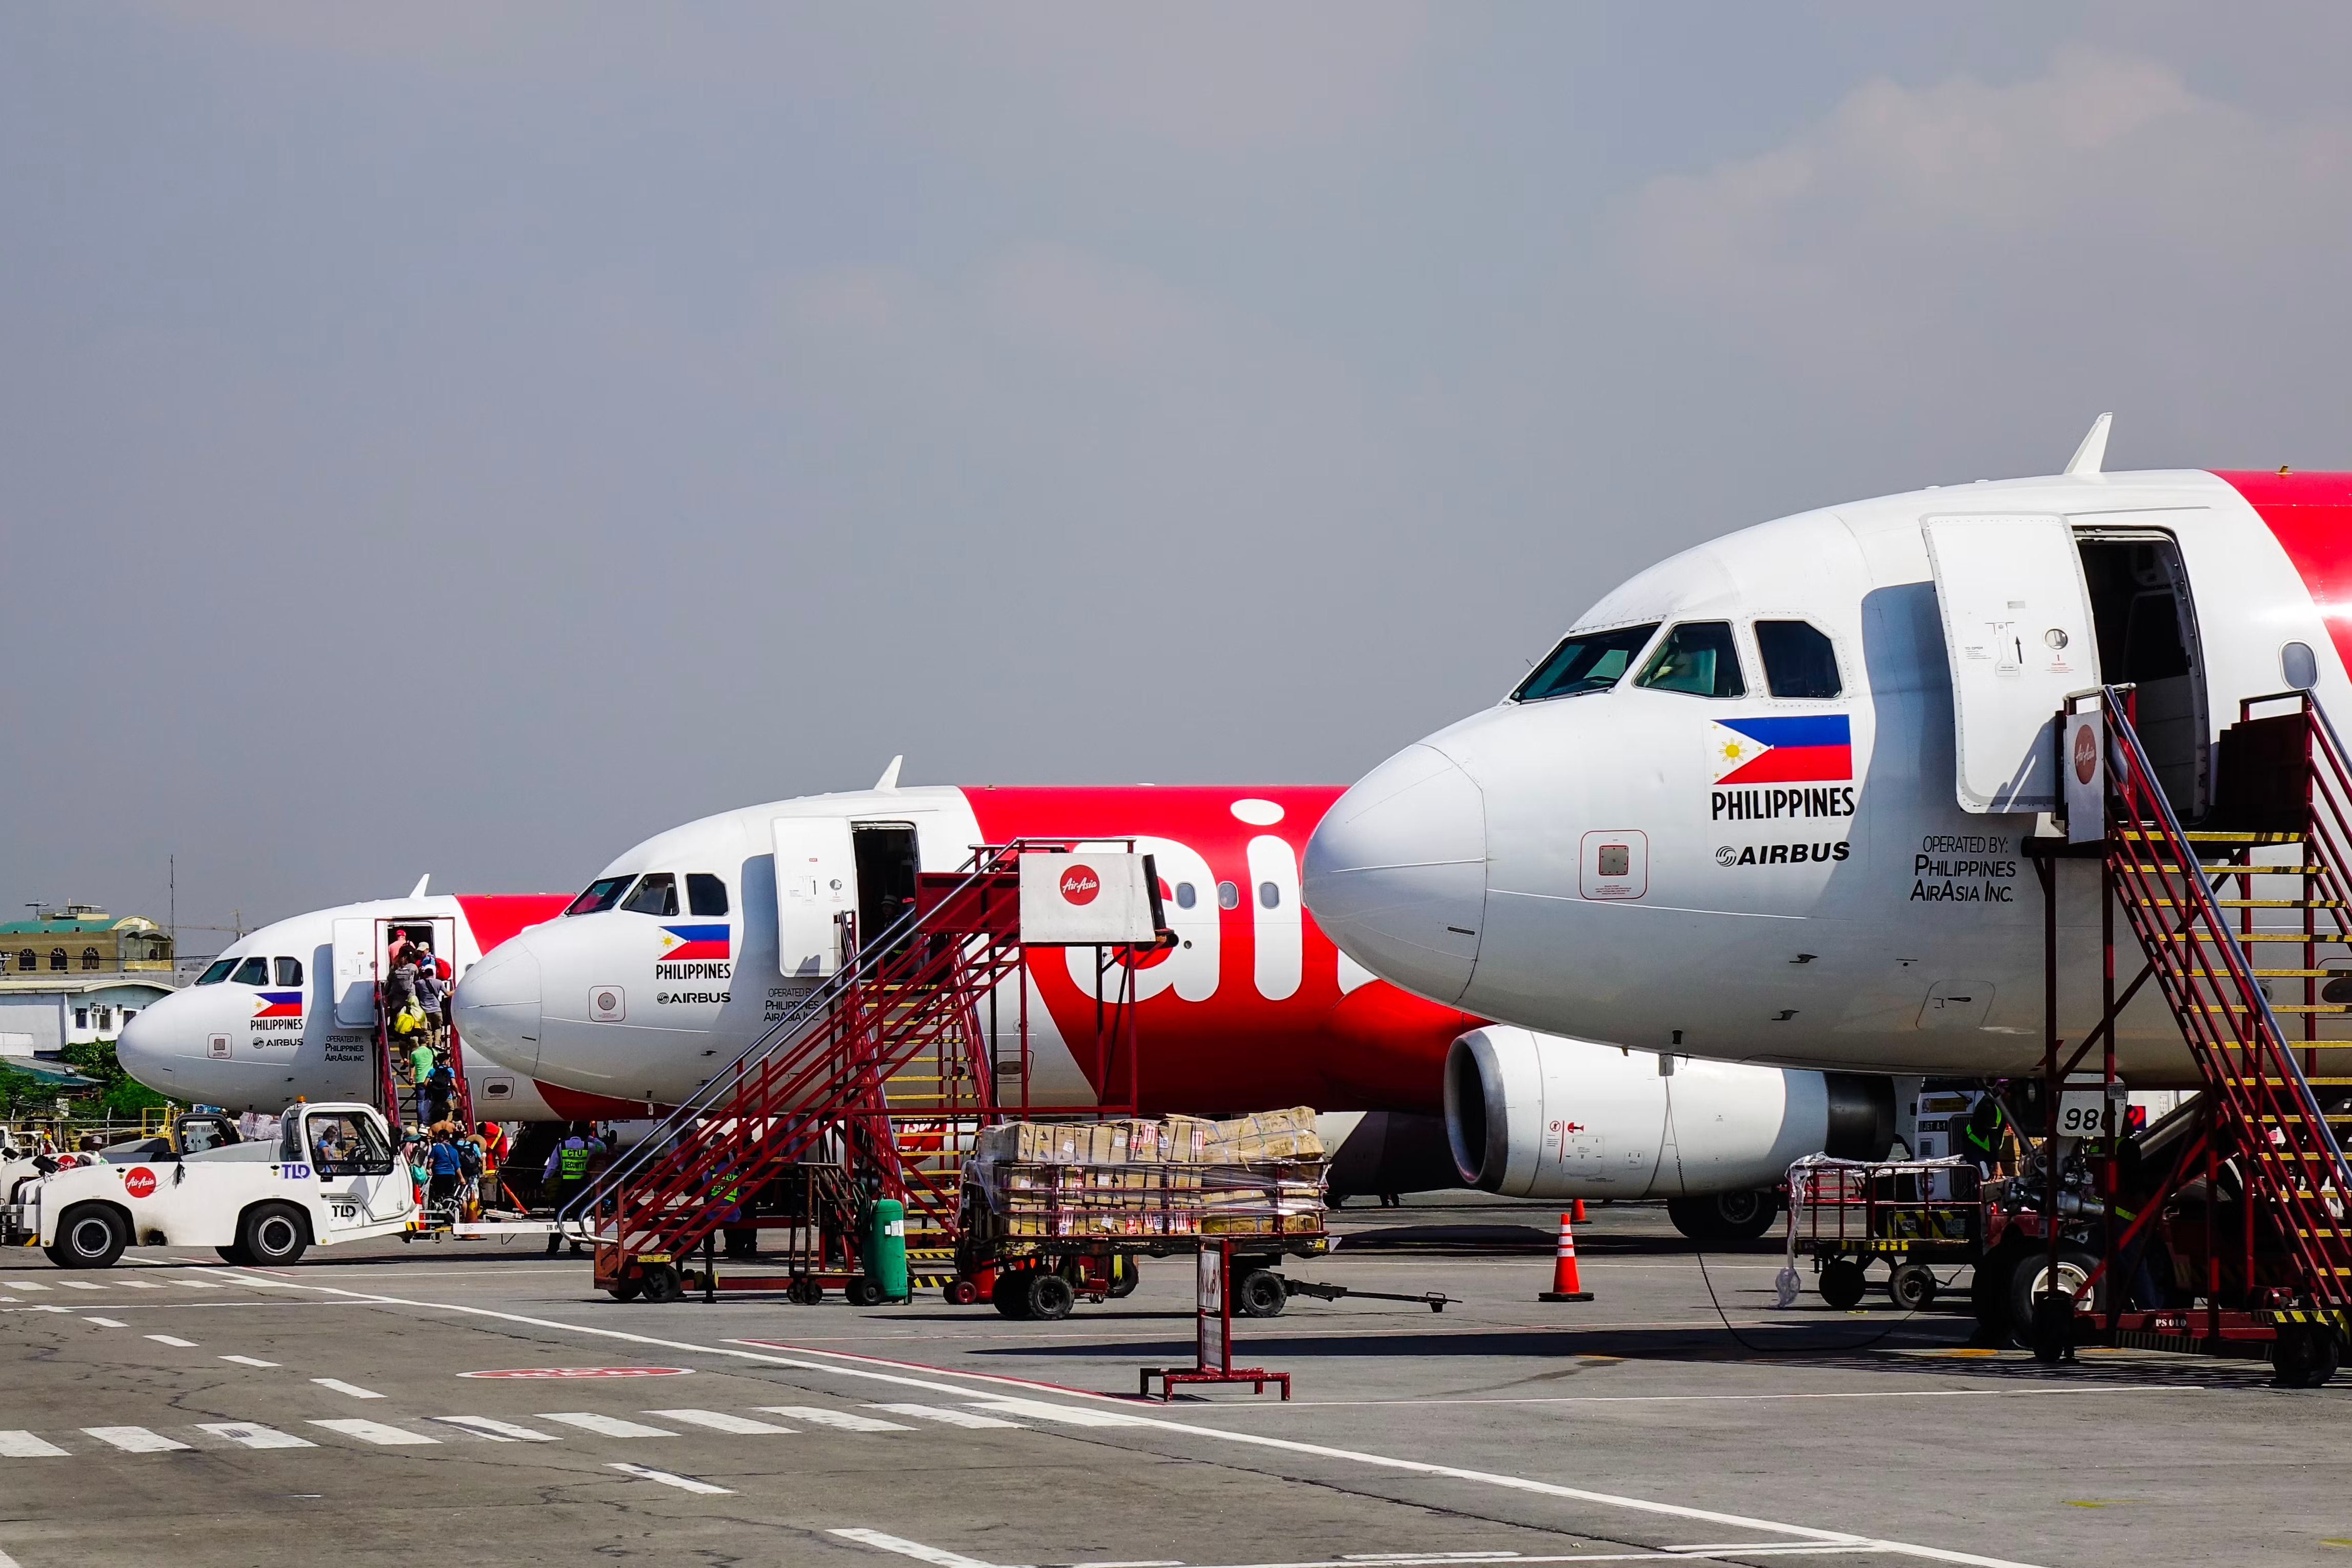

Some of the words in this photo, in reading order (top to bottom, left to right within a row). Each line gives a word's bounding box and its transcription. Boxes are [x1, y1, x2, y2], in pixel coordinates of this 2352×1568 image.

[1712, 787, 1855, 820] PHILIPPINES
[1923, 835, 1986, 853] OPERATED
[1989, 836, 2008, 853] BY:
[1737, 841, 1851, 866] AIRBUS
[1915, 854, 2016, 877] PHILIPPINES
[1062, 877, 1097, 894] AirAsia
[1984, 880, 2013, 902] INC.
[656, 963, 731, 980] PHILIPPINES
[669, 992, 731, 1003] AIRBUS
[768, 988, 804, 997] OPERATED
[250, 1018, 303, 1031] PHILIPPINES
[266, 1038, 304, 1047] AIRBUS
[325, 1043, 364, 1052] PHILIPPINES
[282, 1164, 311, 1179] TLD
[565, 1161, 585, 1169] SECURITY
[127, 1176, 154, 1189] AirAsia
[332, 1205, 356, 1217] TLD
